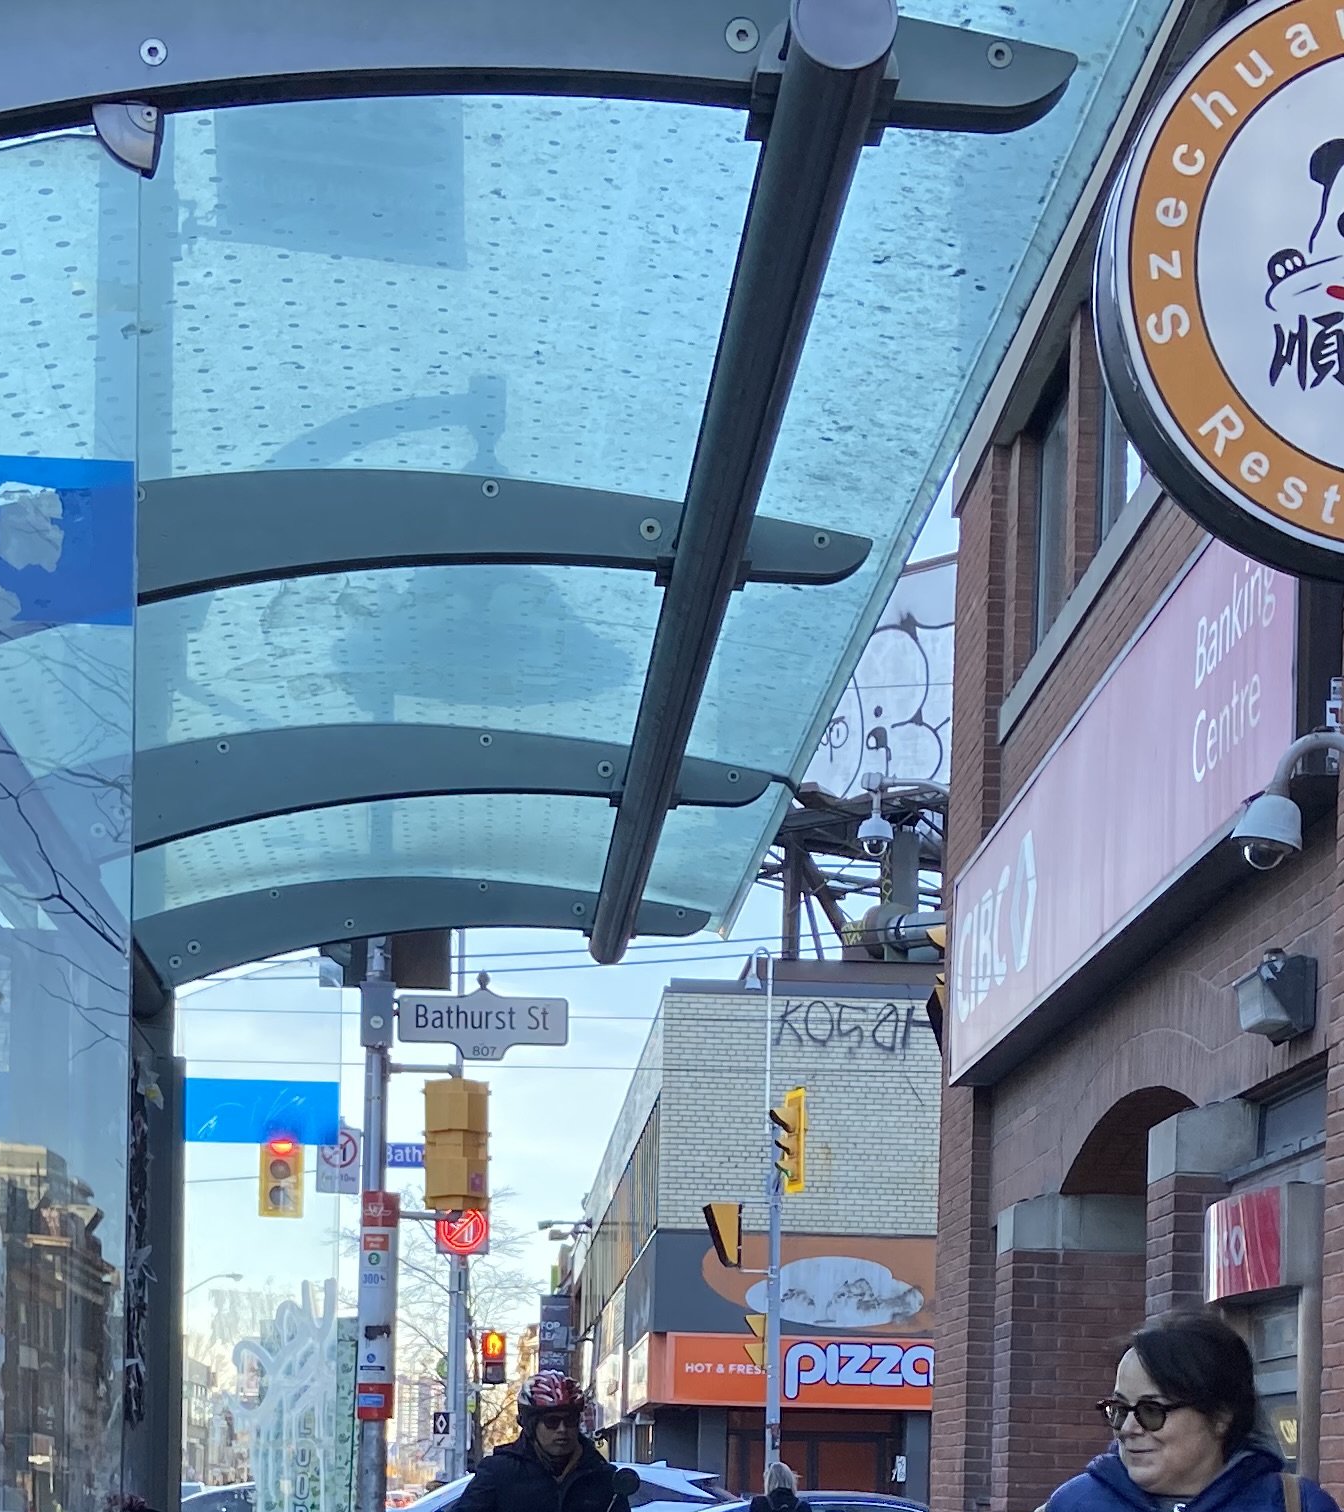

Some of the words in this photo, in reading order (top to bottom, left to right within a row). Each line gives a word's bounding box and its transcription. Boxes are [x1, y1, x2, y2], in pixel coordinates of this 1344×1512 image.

[1193, 560, 1276, 690] Banking
[1191, 672, 1263, 783] Centre
[956, 862, 1011, 1026] CIBC
[415, 1004, 516, 1030] Bathurst
[527, 1006, 550, 1030] St
[472, 1045, 497, 1057] 807
[370, 1254, 377, 1263] 2
[363, 1273, 380, 1285] 300
[685, 1363, 713, 1374] HOT
[716, 1363, 725, 1375] &
[728, 1363, 767, 1375] FRES
[783, 1341, 935, 1400] pizza
